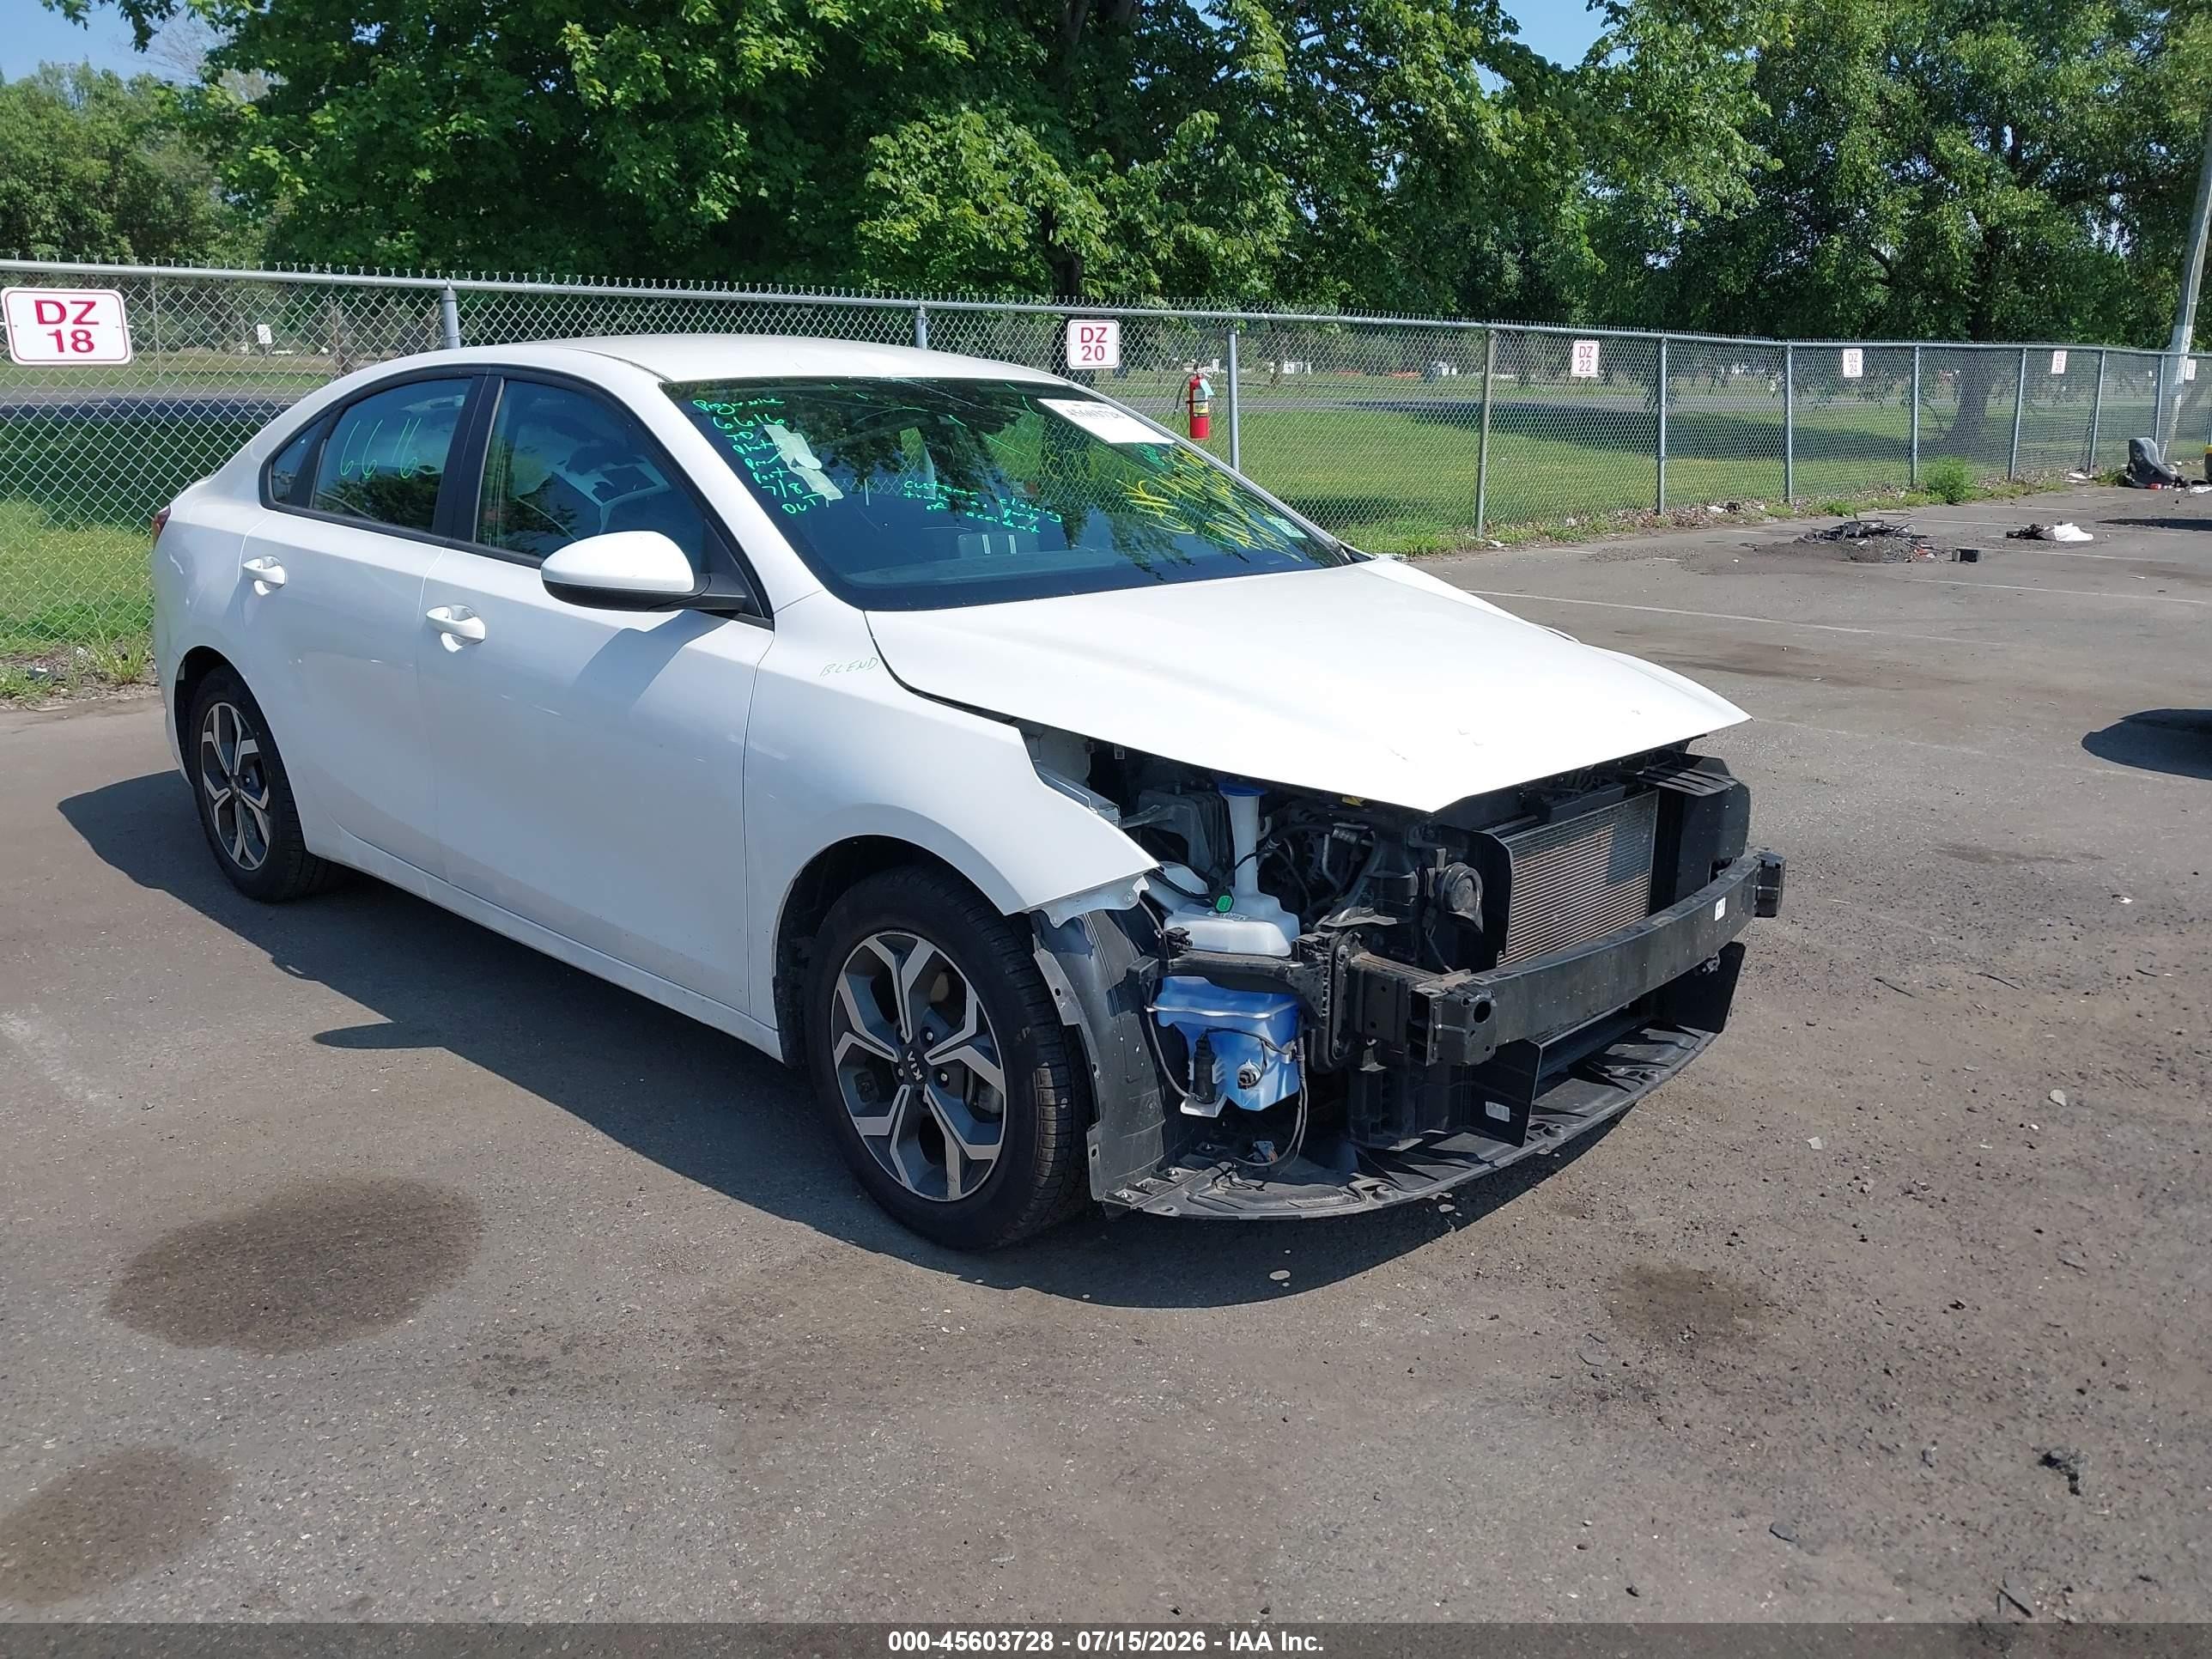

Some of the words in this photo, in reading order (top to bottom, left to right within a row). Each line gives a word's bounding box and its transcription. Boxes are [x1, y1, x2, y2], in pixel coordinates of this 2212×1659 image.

[34, 300, 100, 325] DZ
[46, 329, 95, 353] 18
[1080, 327, 1107, 343] DZ
[1081, 345, 1105, 361] 20
[1579, 346, 1593, 358] DZ
[1848, 353, 1858, 363] DZ
[1579, 360, 1591, 372] 22
[713, 413, 786, 429] 6616
[340, 417, 422, 480] 6616
[762, 479, 804, 499] 7/8
[819, 657, 878, 678] BLEND
[908, 1050, 923, 1080] KIA
